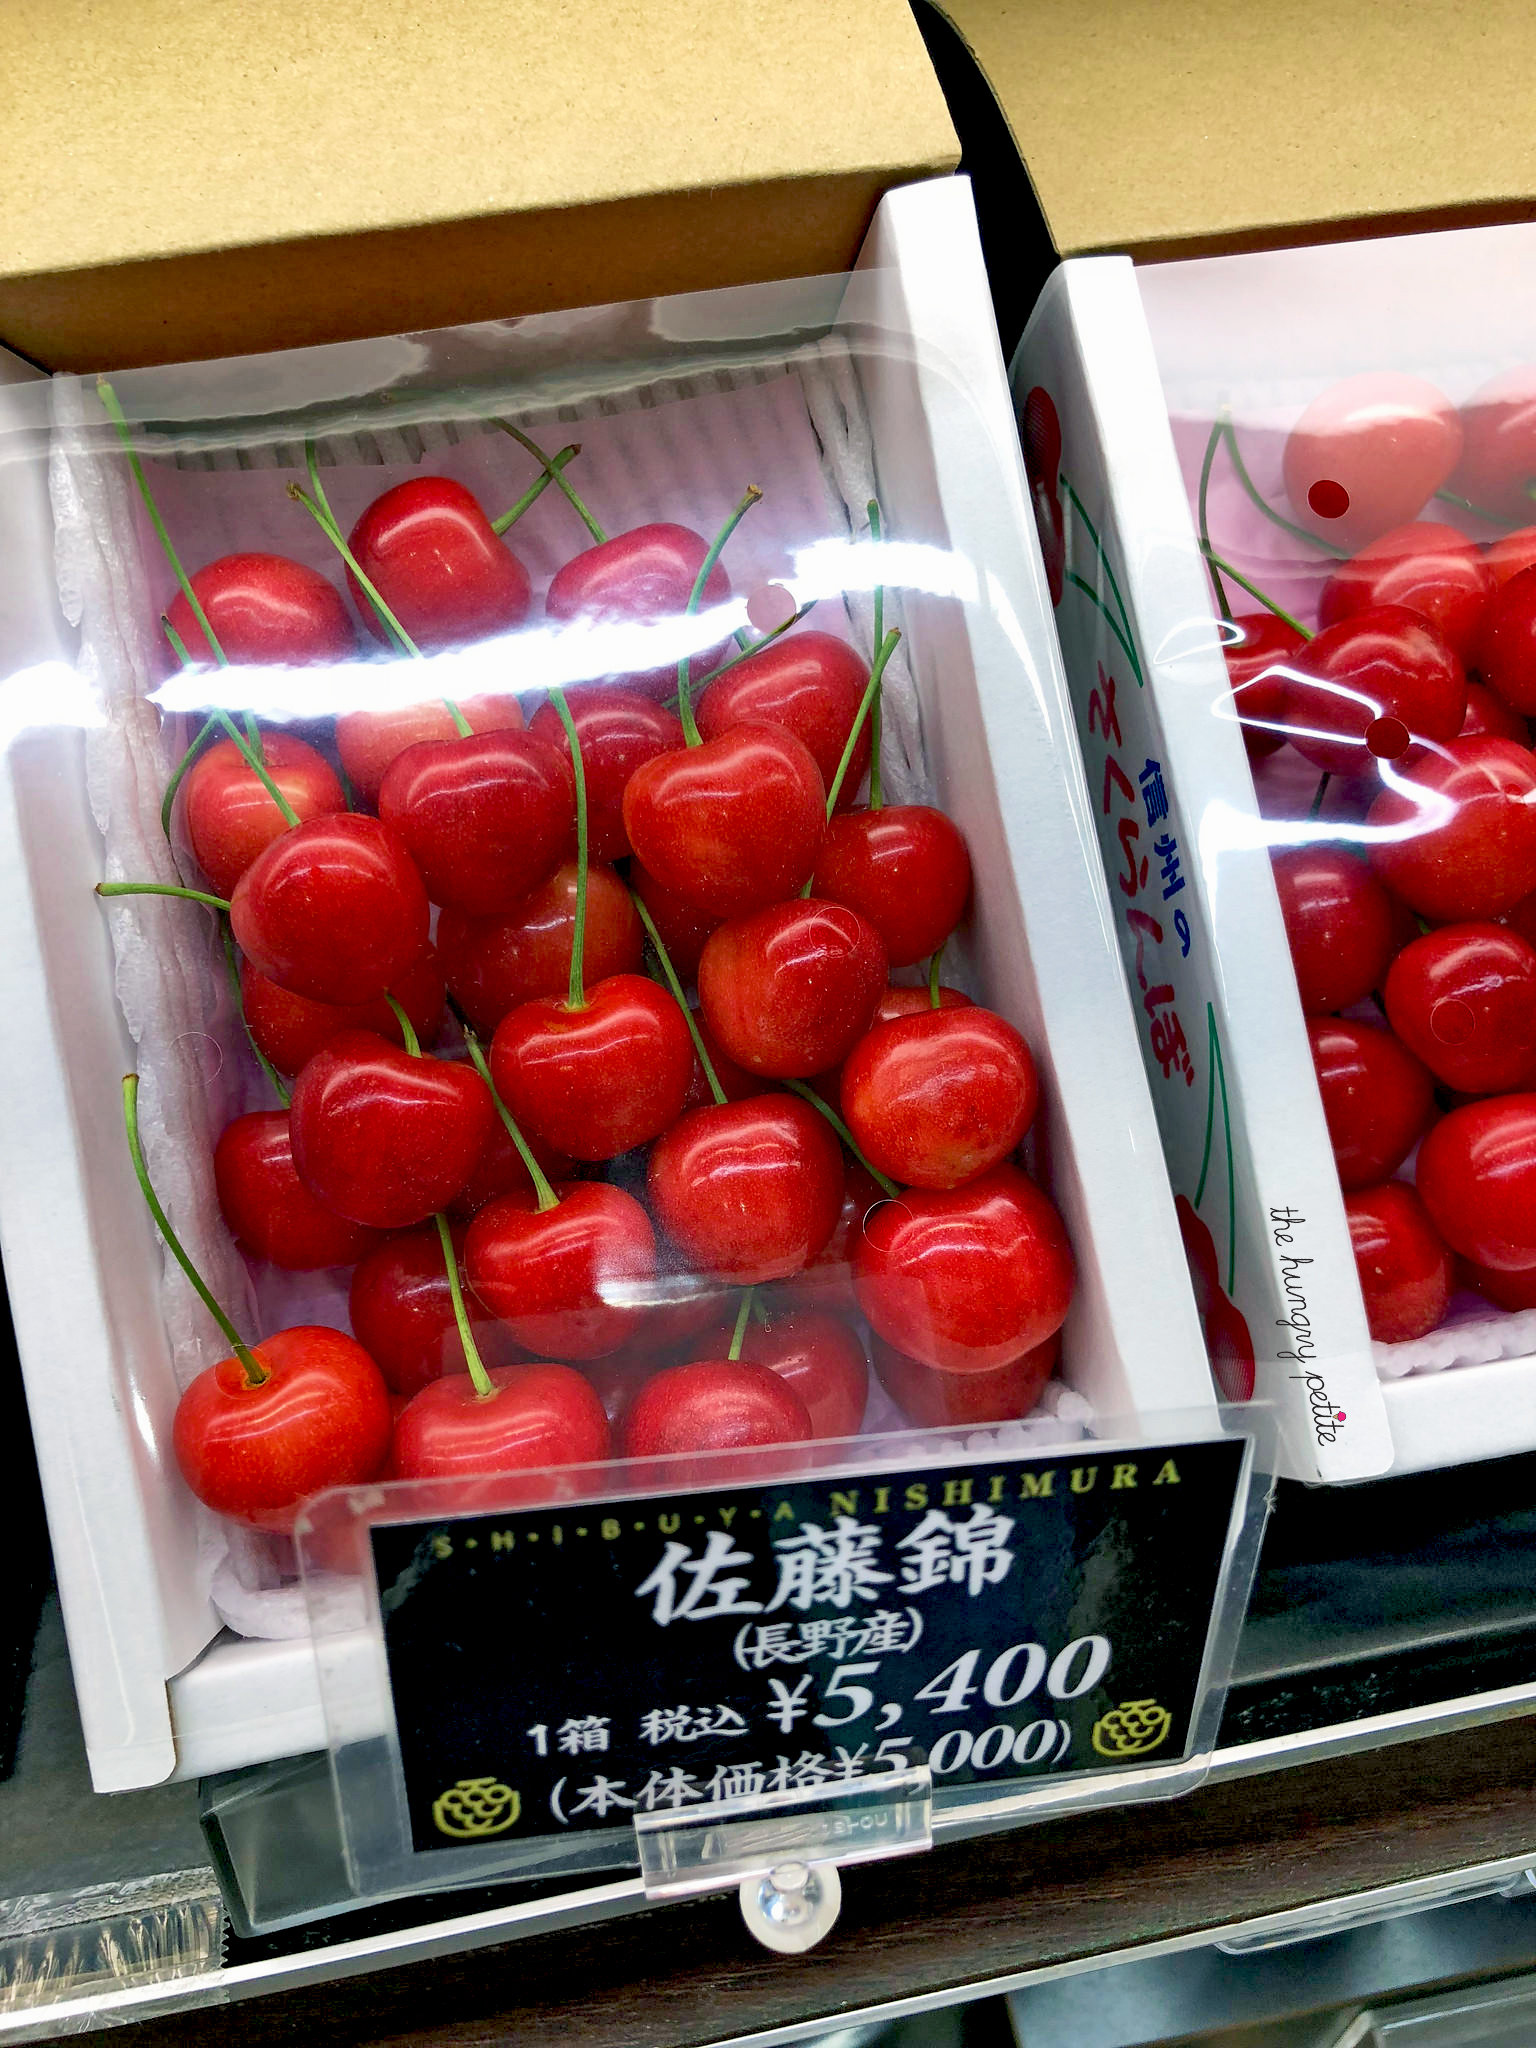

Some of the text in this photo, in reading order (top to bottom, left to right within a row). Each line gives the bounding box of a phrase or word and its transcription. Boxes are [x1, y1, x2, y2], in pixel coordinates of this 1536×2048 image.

[1087, 659, 1196, 1088] さくらんぼ
[1138, 757, 1192, 959] 信州の
[829, 1458, 1182, 1518] NISHIMURA
[634, 1501, 1016, 1627] 佐藤錦
[526, 1634, 1112, 1757] 1箱 税込 ¥5,400
[733, 1606, 924, 1671] (長野産)
